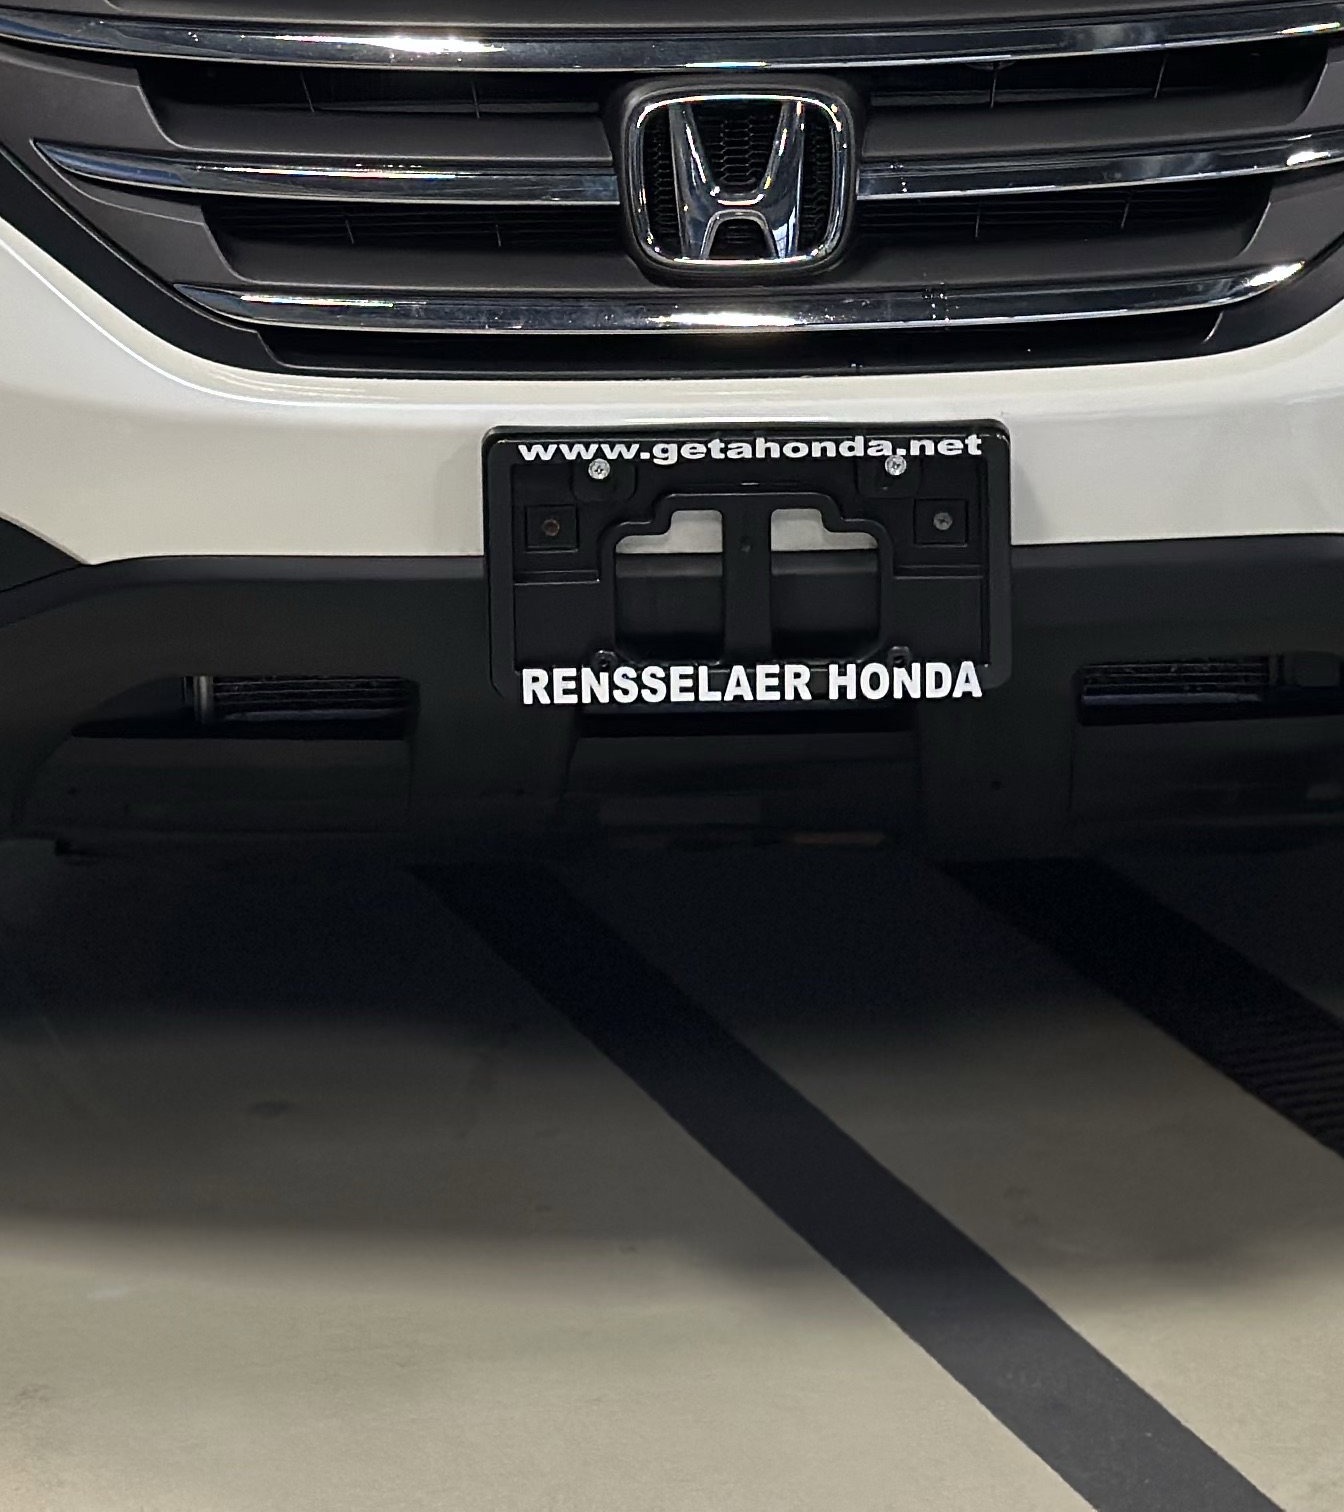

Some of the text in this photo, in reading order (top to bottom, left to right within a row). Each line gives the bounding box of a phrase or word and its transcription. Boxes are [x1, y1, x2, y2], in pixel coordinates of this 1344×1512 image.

[517, 433, 983, 466] www.getahonda.net
[522, 660, 983, 705] RENSSELAER HONDA
